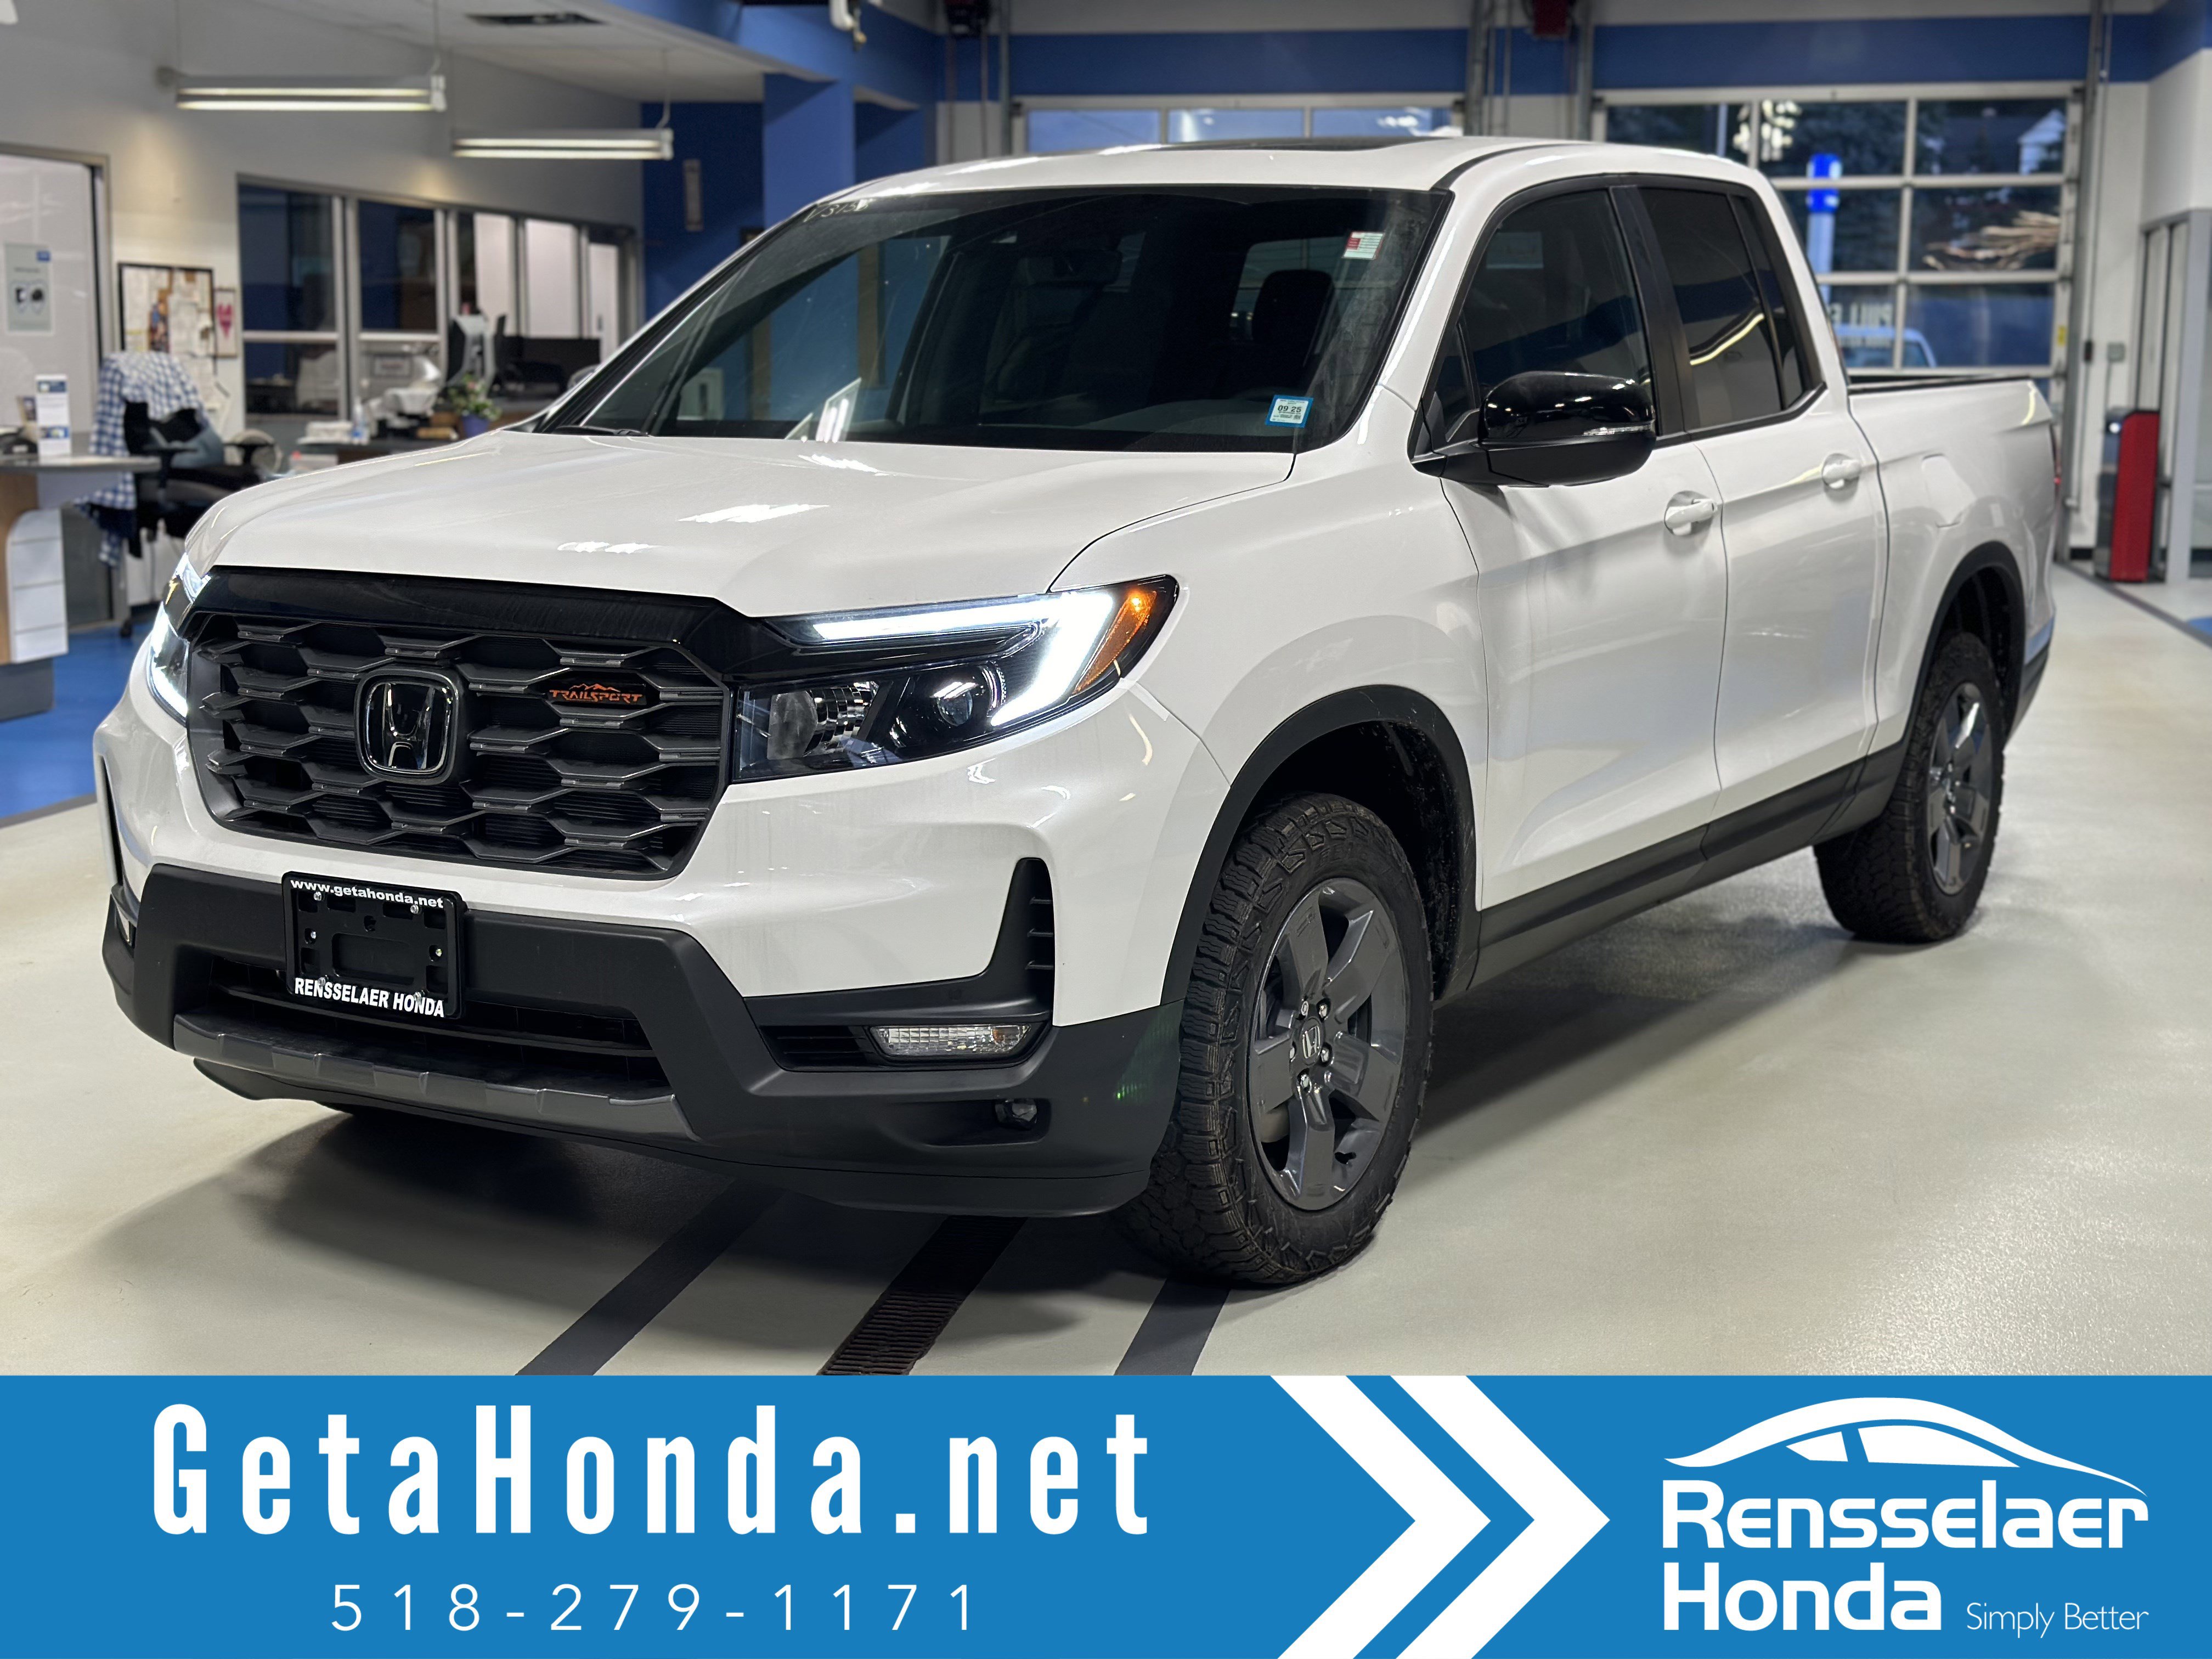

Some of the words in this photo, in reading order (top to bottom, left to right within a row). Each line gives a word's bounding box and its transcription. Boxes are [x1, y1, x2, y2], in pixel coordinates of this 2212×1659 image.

[549, 690, 643, 703] TRAILSPORT
[291, 880, 444, 909] www.getahonda.net
[294, 978, 389, 1008] RENSSELAER
[393, 993, 444, 1017] HONDA
